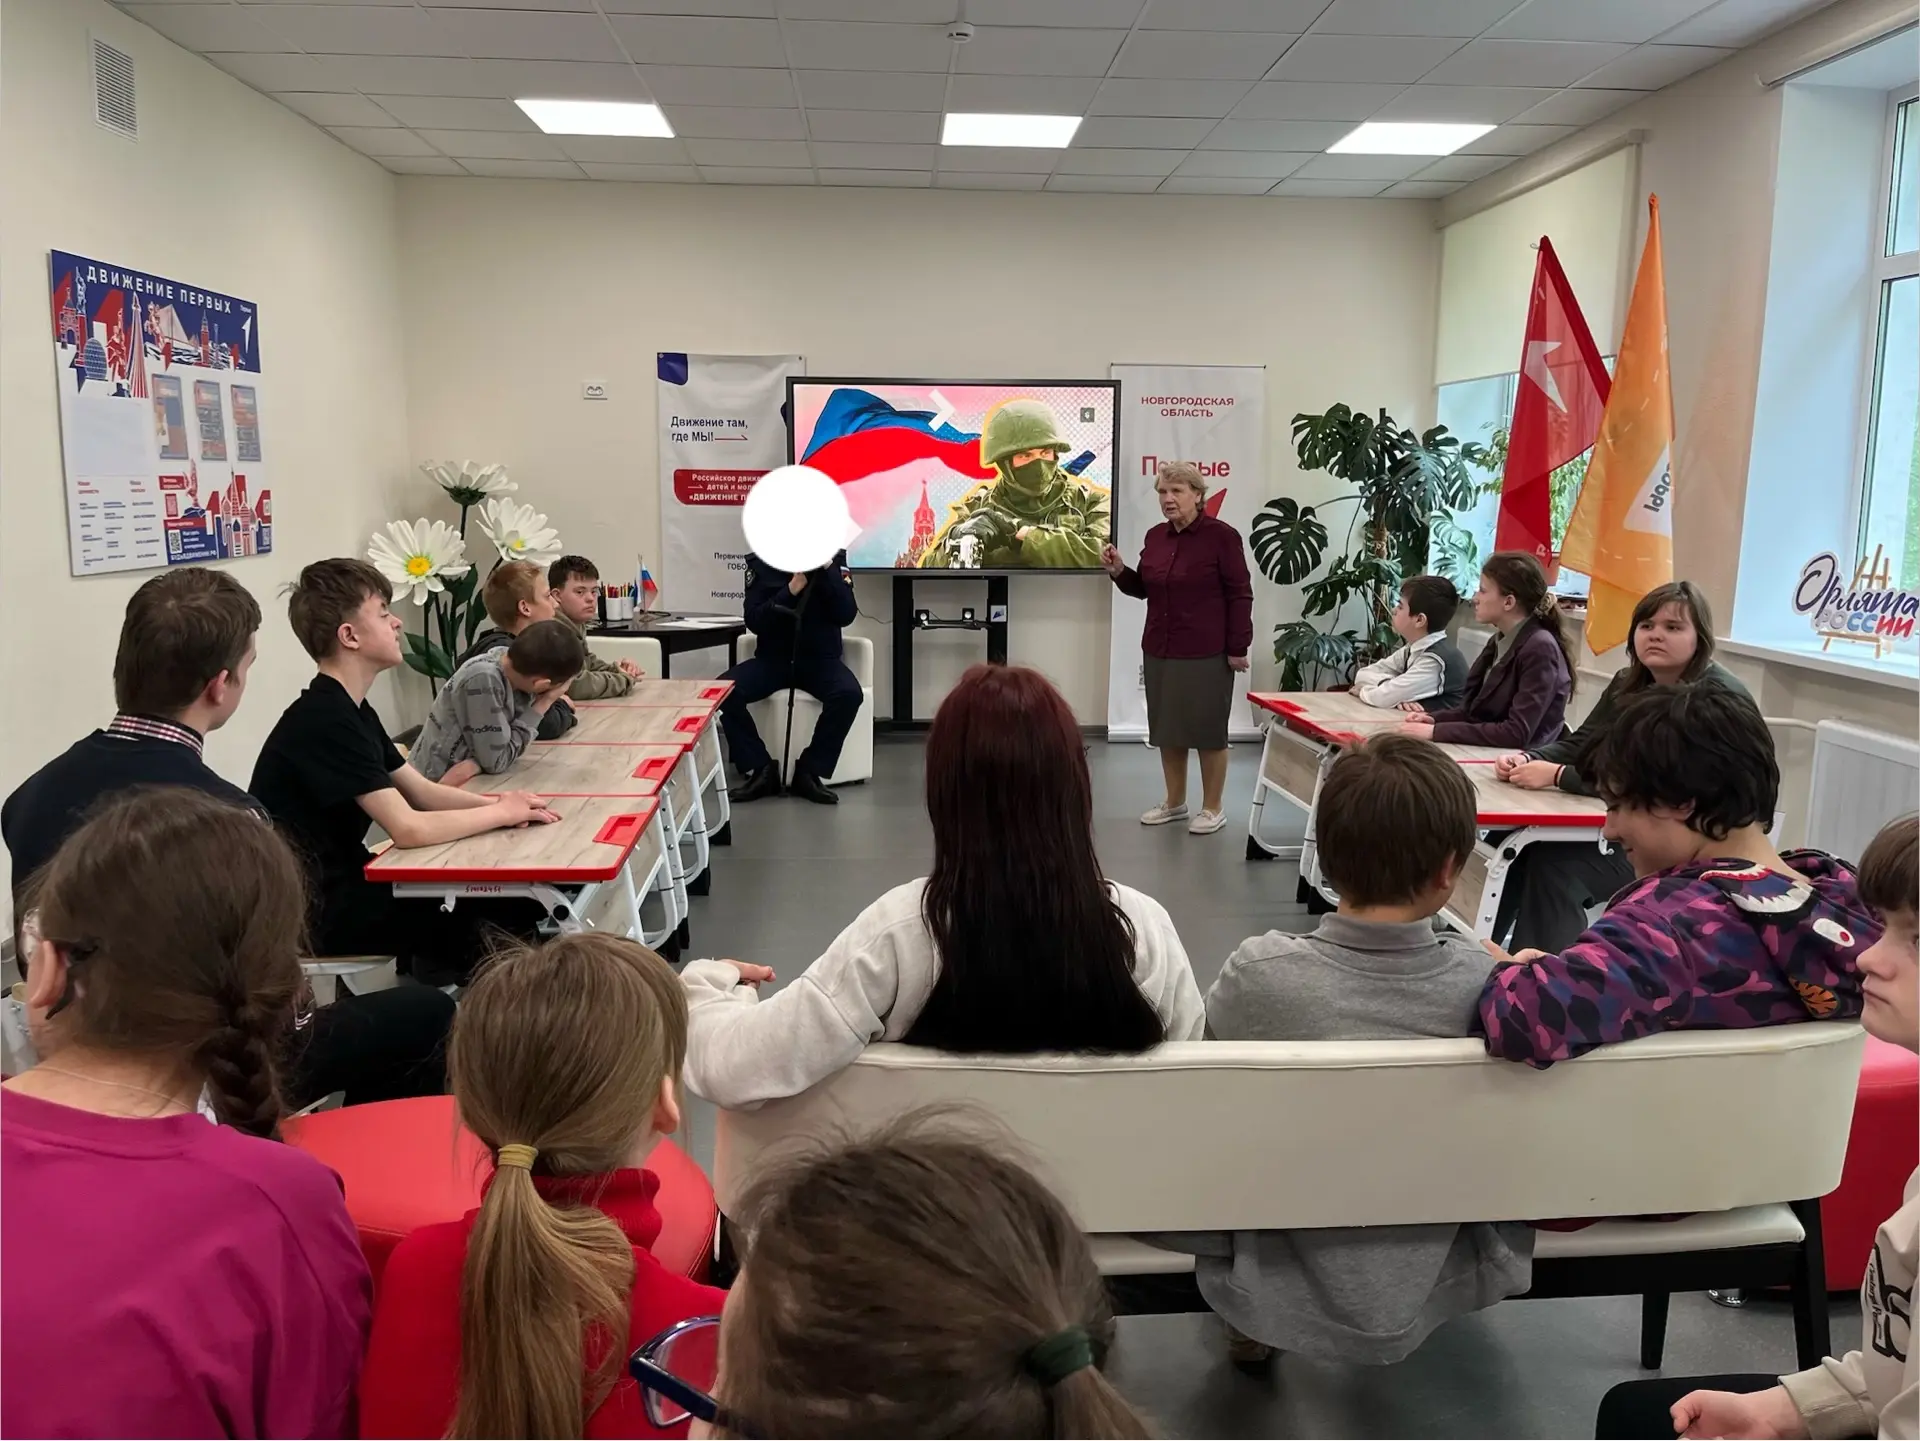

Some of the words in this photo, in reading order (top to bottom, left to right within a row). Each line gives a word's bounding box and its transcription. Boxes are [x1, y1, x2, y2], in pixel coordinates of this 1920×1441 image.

[87, 265, 174, 299] ДВИЖЕНИЕ
[180, 288, 232, 314] ПЕРВЫХ
[1141, 396, 1234, 406] НОВГОРОДСКАЯ
[1160, 408, 1214, 417] ОБЛАСТЬ
[671, 416, 724, 428] Движение
[726, 419, 748, 429] там,
[671, 432, 689, 442] где
[692, 431, 714, 441] МЫ!
[1142, 456, 1230, 477] Пые
[692, 473, 736, 482] Российское
[1795, 554, 1920, 619] Орлята
[1815, 609, 1914, 637] РОССИИ
